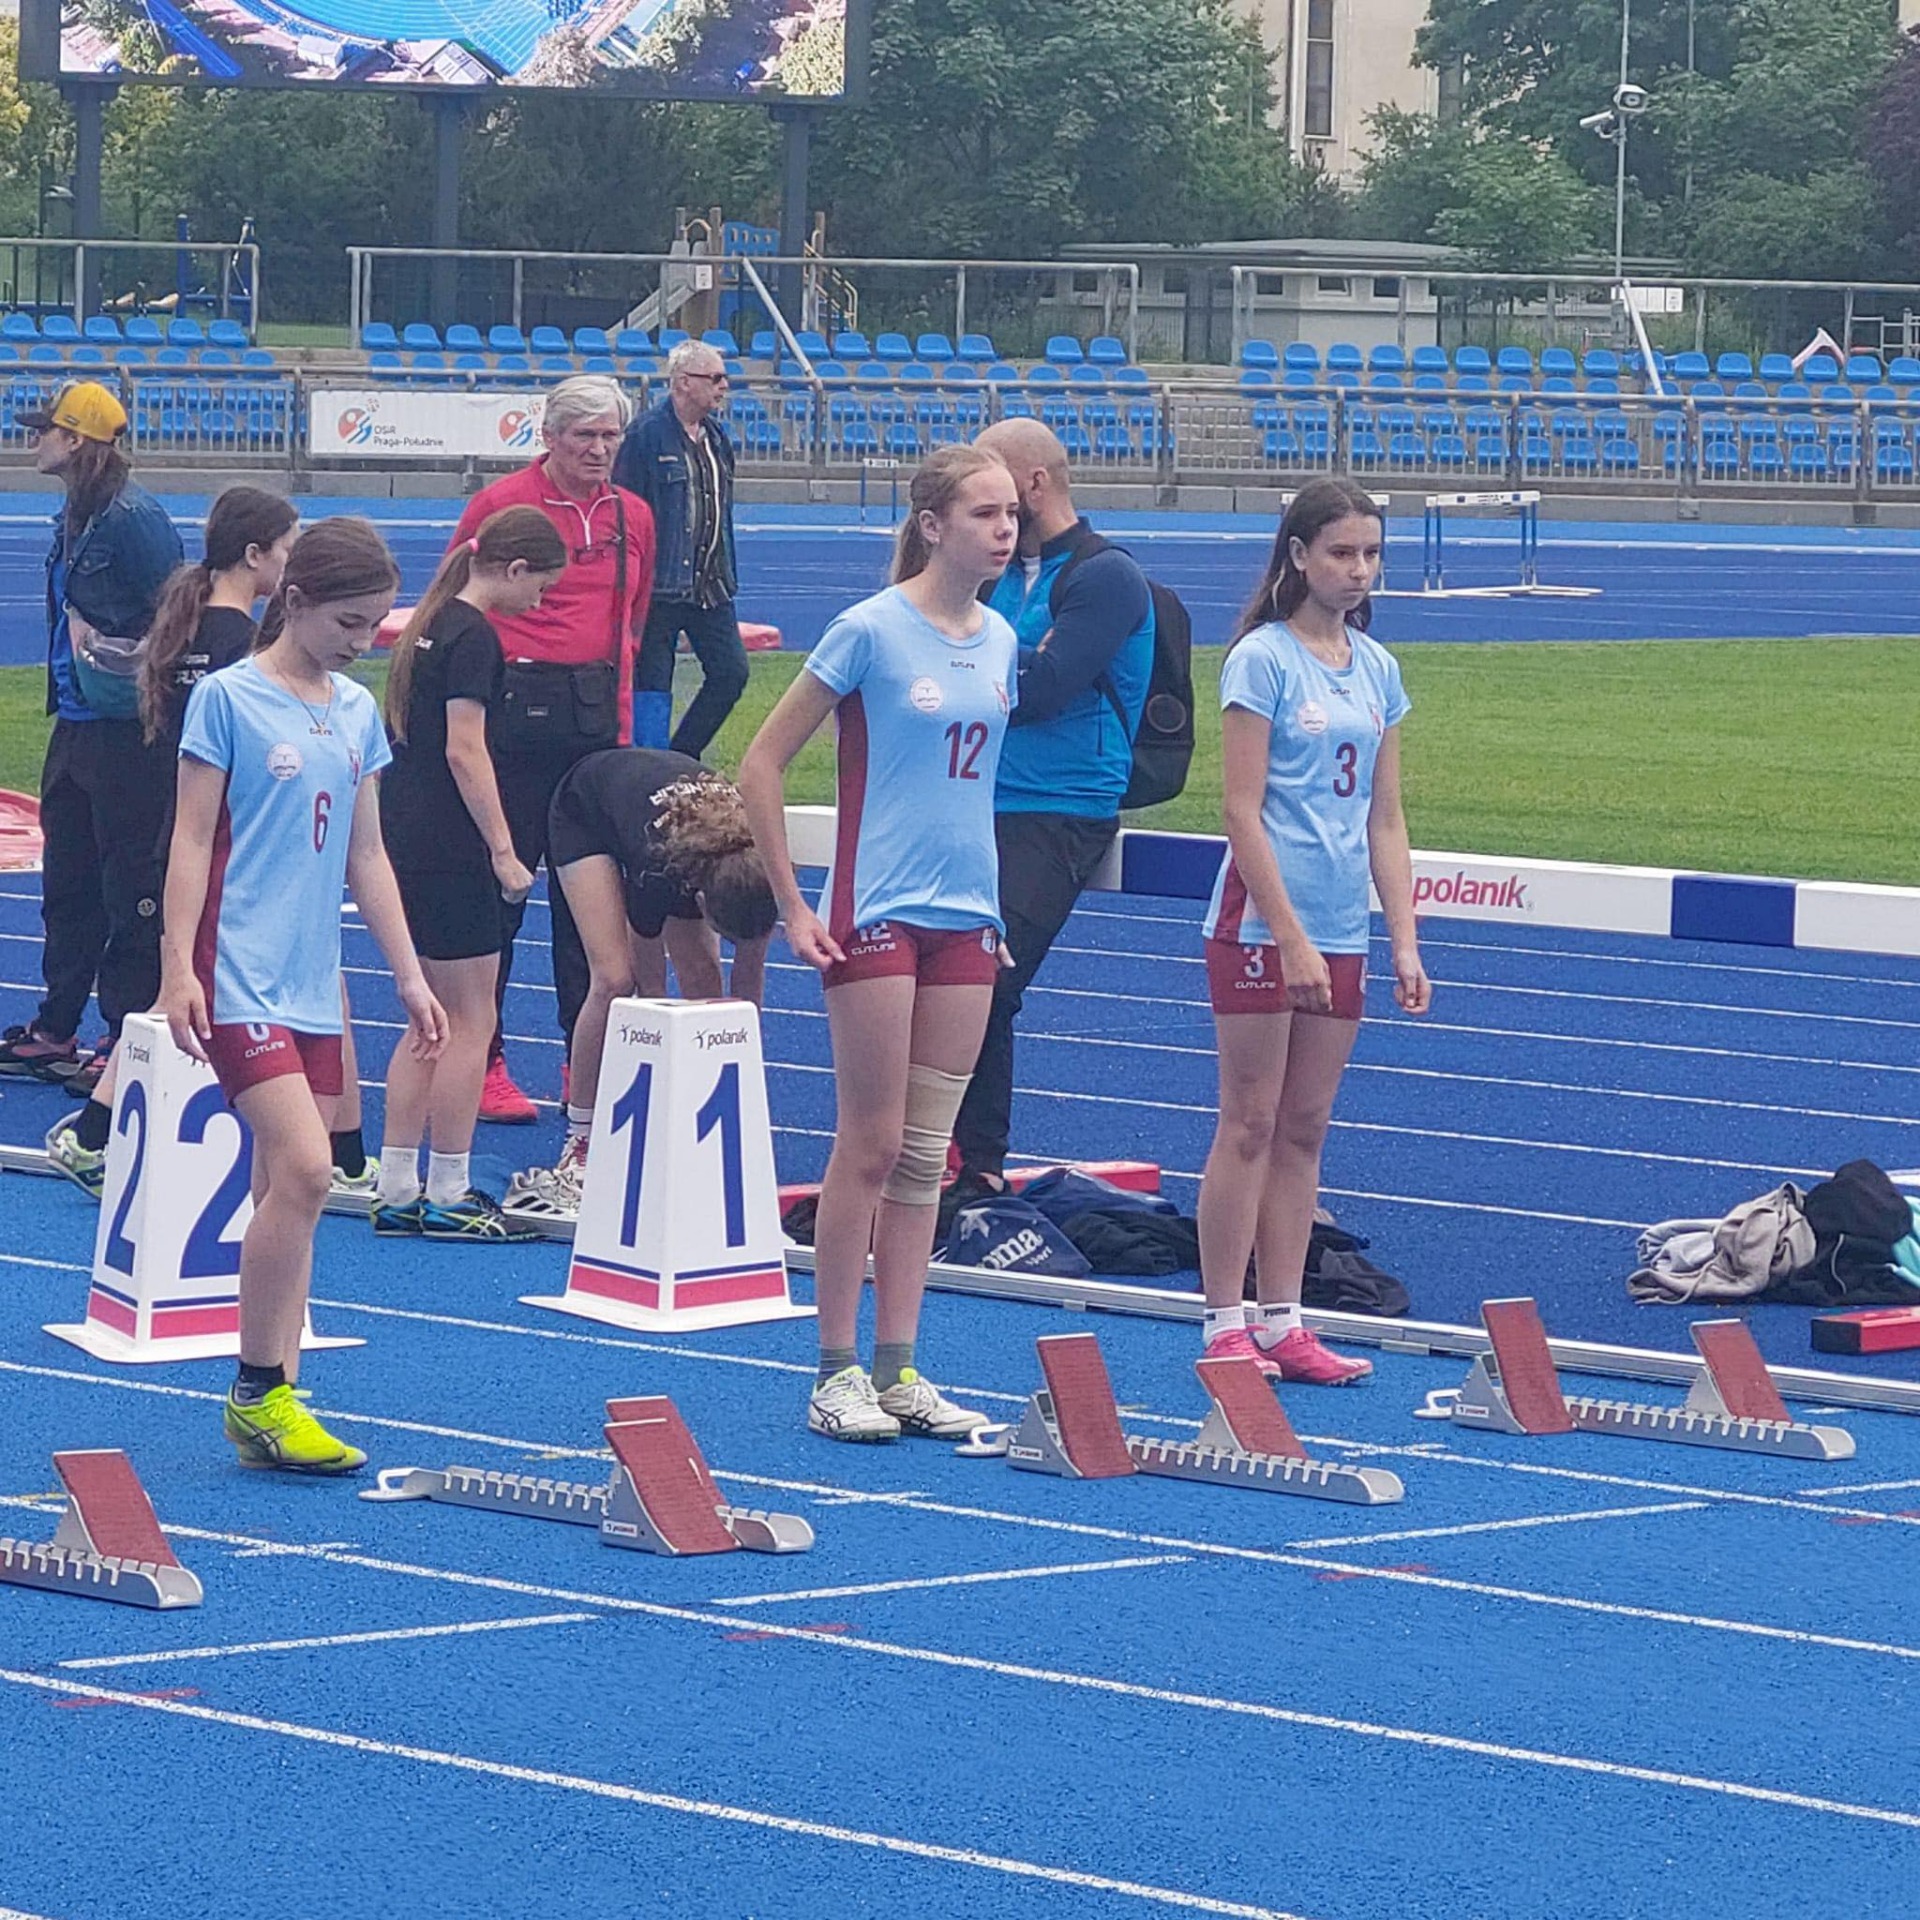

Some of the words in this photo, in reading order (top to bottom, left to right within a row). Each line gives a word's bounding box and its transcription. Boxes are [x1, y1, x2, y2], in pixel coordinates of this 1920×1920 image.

[944, 721, 988, 780] 12
[1333, 741, 1358, 798] 3
[314, 790, 332, 854] 6
[1413, 871, 1528, 909] polanik
[1243, 946, 1265, 978] 3
[707, 1027, 747, 1050] polanik
[104, 1079, 146, 1277] 2
[177, 1083, 253, 1279] 2
[611, 1061, 653, 1248] 1
[696, 1061, 746, 1248] 1
[976, 1228, 1043, 1270] oma
